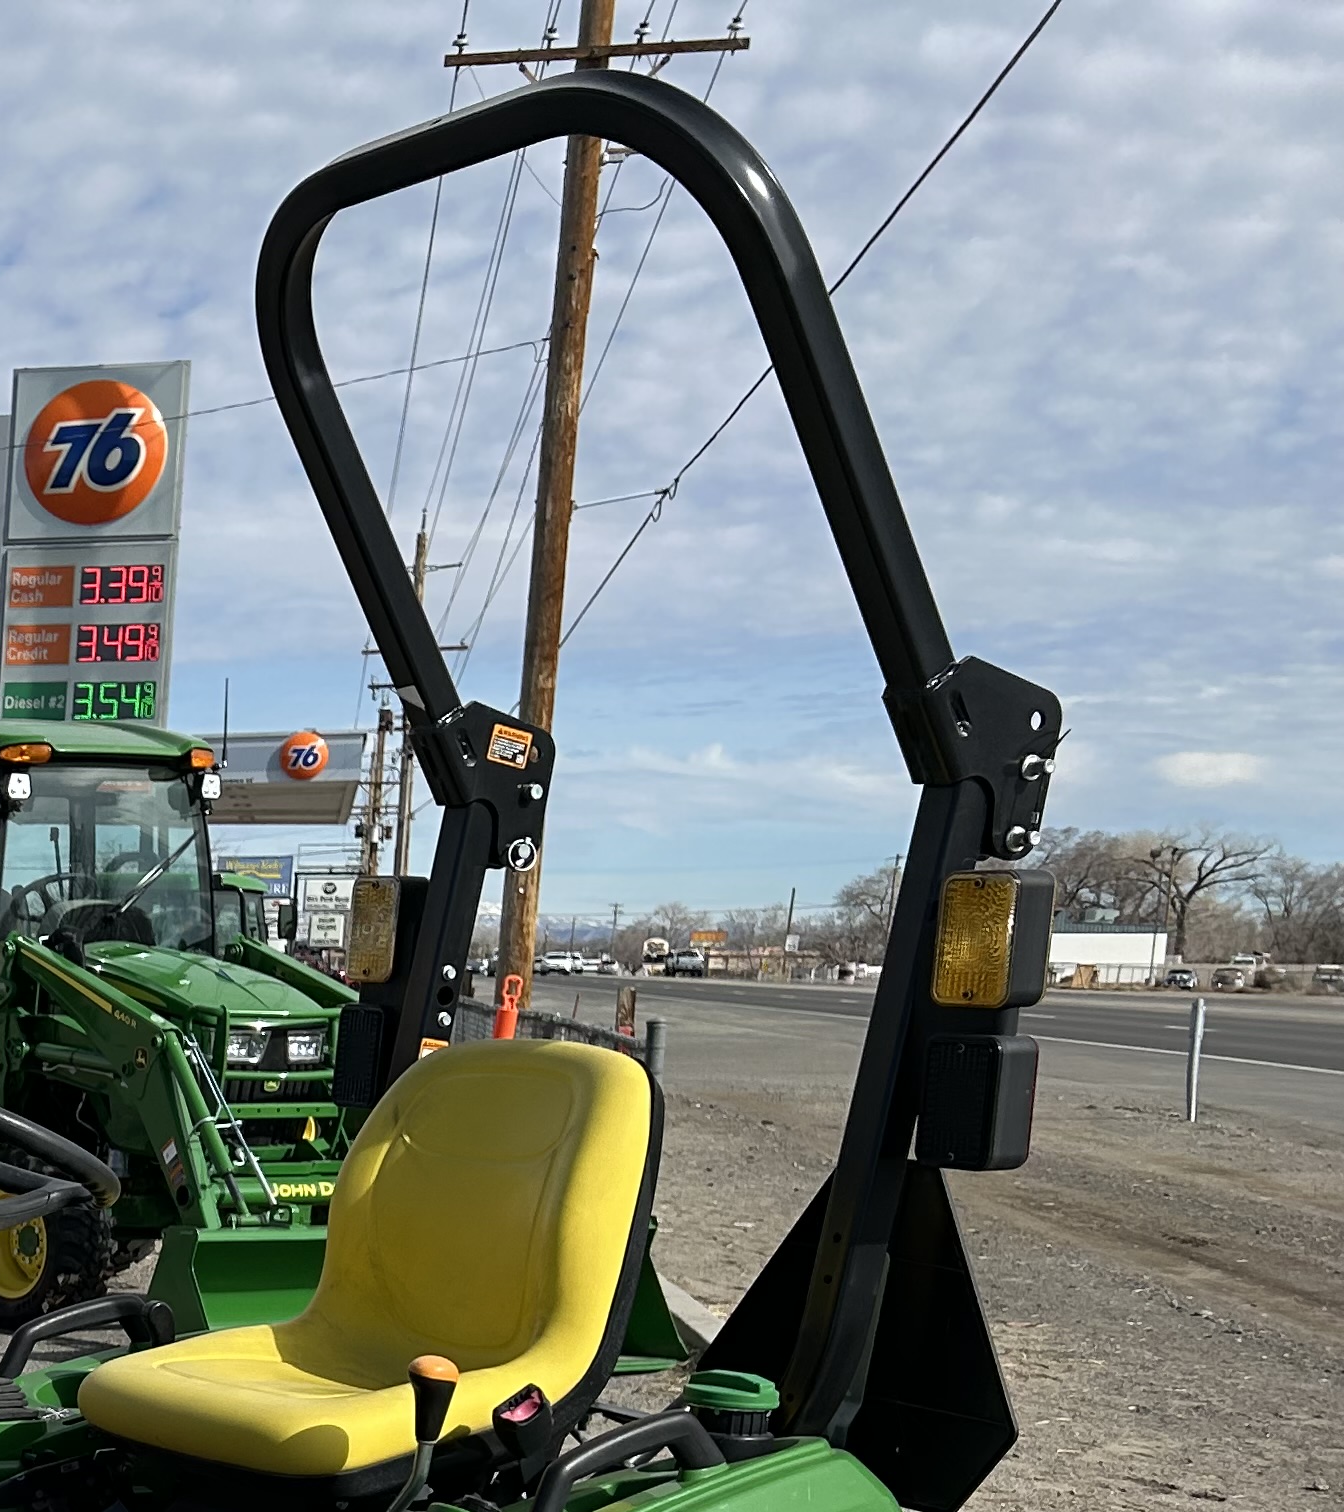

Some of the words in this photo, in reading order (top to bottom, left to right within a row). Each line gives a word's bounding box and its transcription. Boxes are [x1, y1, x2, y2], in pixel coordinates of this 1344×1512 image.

[42, 407, 146, 495] 76
[12, 571, 62, 588] Regular
[82, 566, 149, 604] 3.39
[12, 589, 43, 603] Cash
[7, 647, 48, 661] Credit
[8, 629, 59, 646] Regular
[77, 624, 145, 662] 3.49
[4, 695, 44, 710] Diesel
[48, 695, 65, 708] #2
[73, 683, 141, 719] 3.54
[288, 742, 322, 770] 76
[272, 1182, 317, 1198] JOHN
